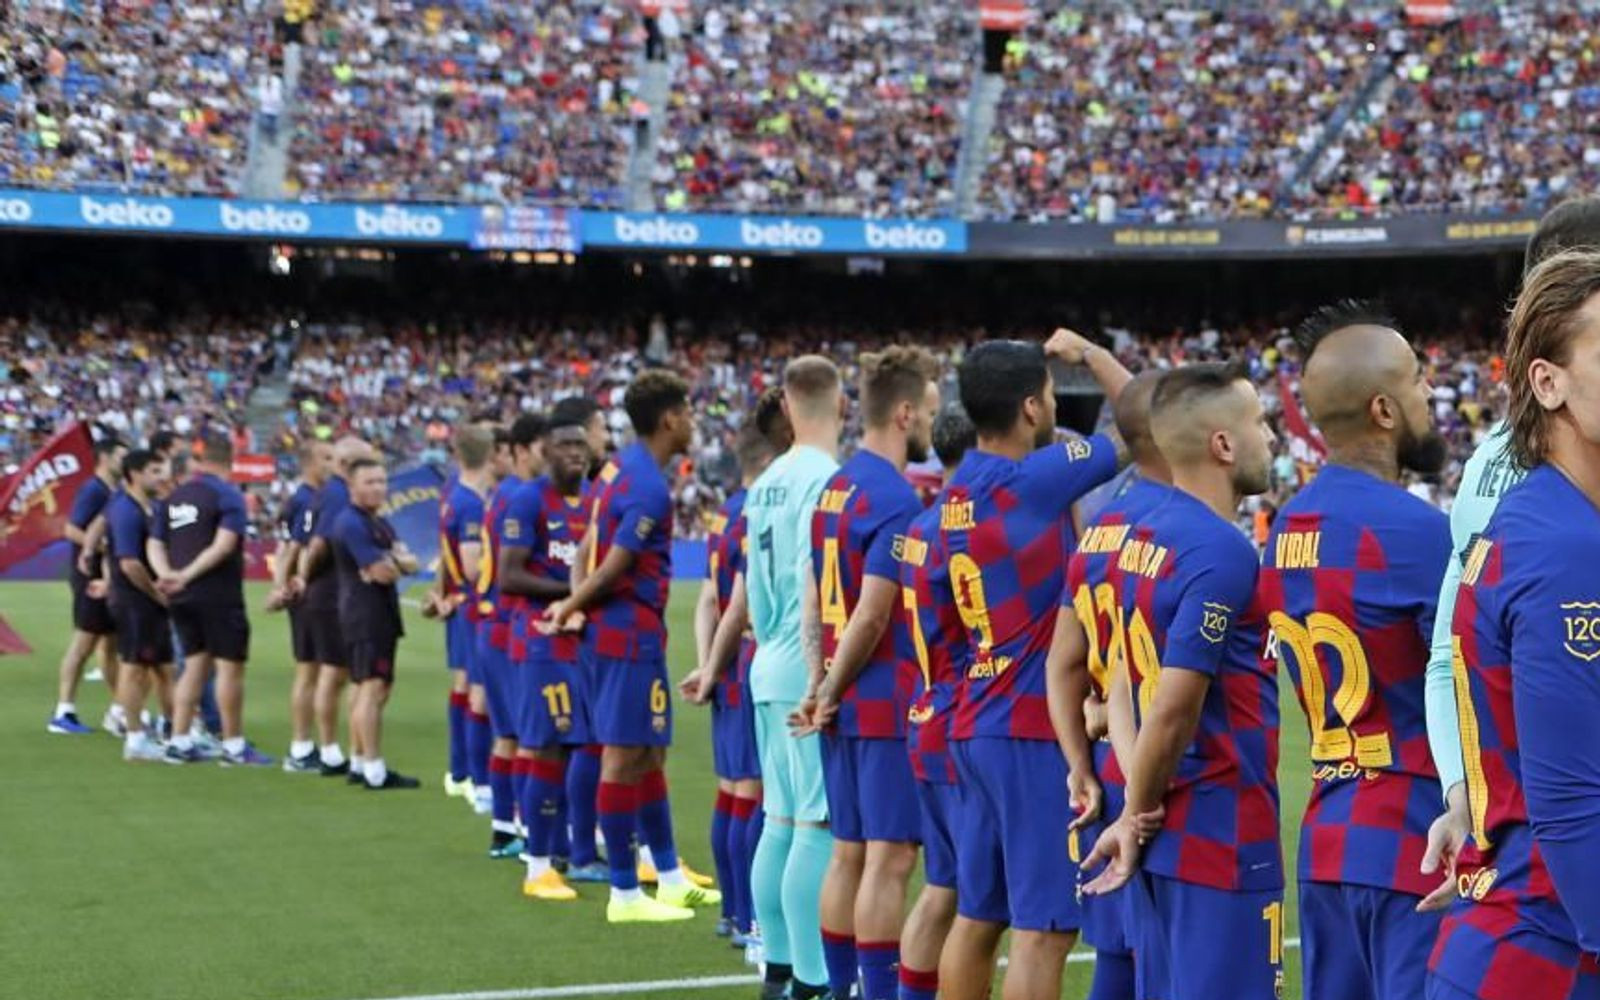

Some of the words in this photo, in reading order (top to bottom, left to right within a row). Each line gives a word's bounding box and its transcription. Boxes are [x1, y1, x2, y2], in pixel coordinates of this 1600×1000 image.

[81, 194, 173, 227] beko
[220, 201, 311, 232] beko
[355, 205, 443, 237] beko
[615, 216, 699, 244] beko
[740, 220, 823, 247] beko
[865, 223, 947, 249] beko
[1275, 532, 1320, 569] VIDAL
[820, 537, 848, 640] 4
[949, 552, 994, 651] 9
[1201, 611, 1227, 632] 120
[542, 682, 572, 716] 11
[651, 680, 668, 714] 6
[1268, 610, 1393, 767] 22
